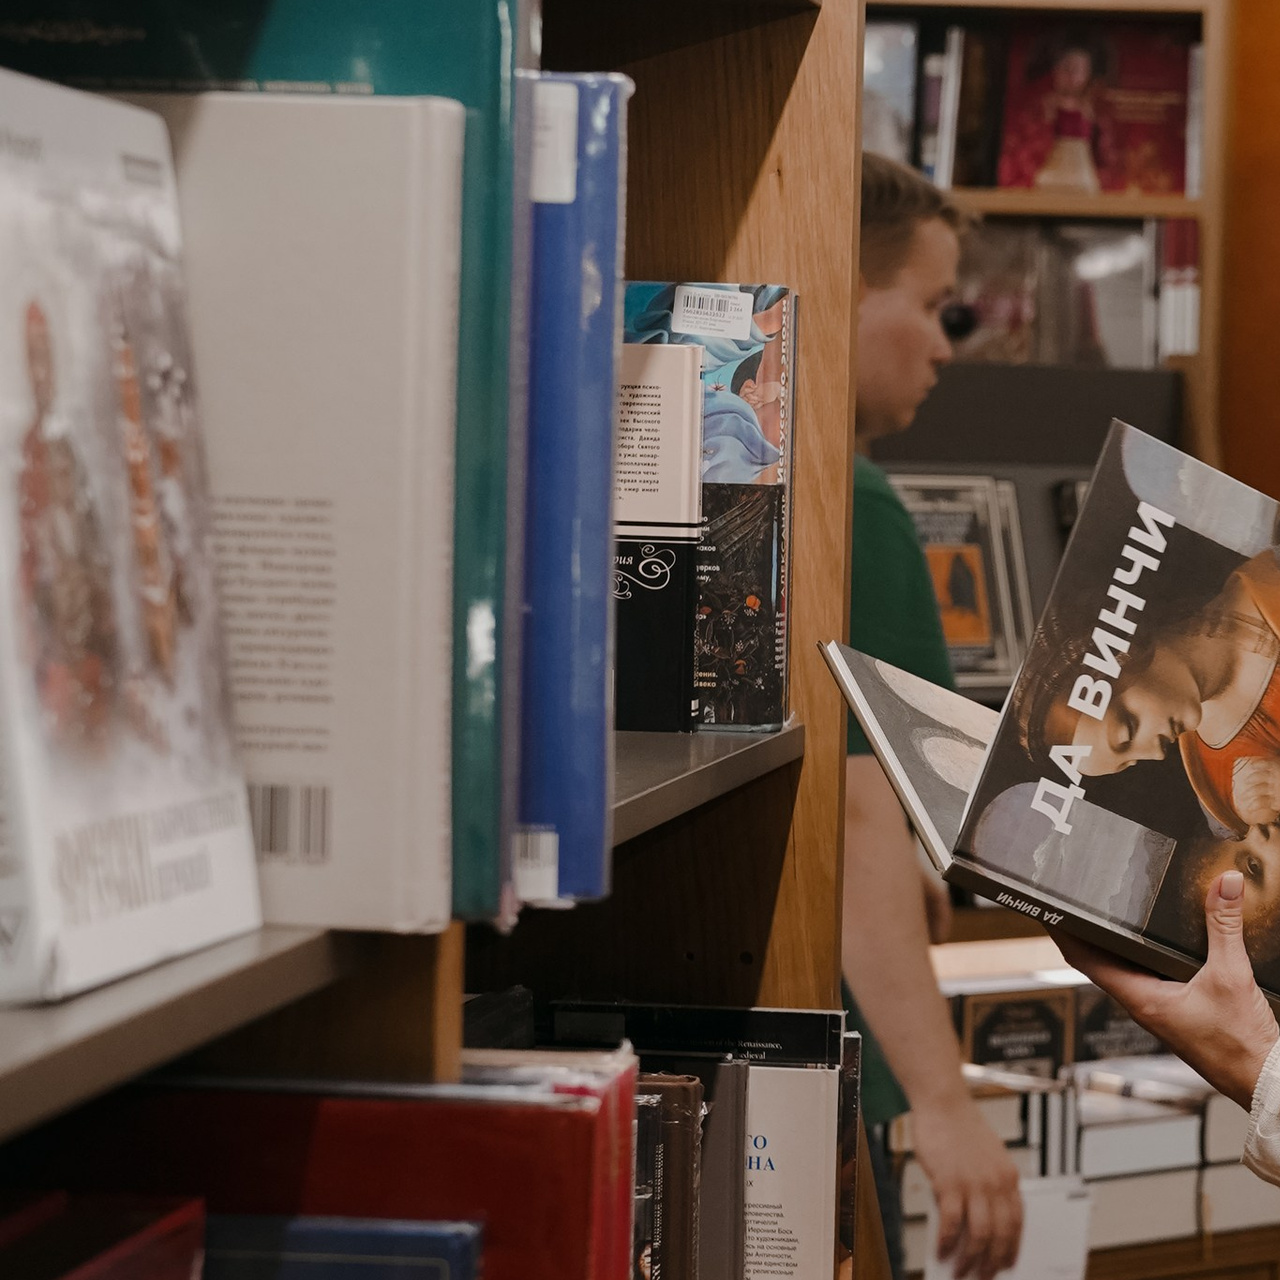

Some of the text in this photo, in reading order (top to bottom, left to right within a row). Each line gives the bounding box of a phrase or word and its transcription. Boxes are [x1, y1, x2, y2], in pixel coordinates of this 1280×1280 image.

[776, 299, 788, 483] Искусство эпохи
[639, 434, 660, 442] Давида
[1030, 500, 1176, 836] ДА ВИНЧИ
[995, 891, 1064, 926] ДА ВИНЧИ
[737, 1040, 783, 1050] Renaissance,
[739, 1051, 766, 1060] edieval
[745, 1156, 776, 1172] НА
[744, 1202, 783, 1210] рессивный
[747, 1226, 793, 1235] Иероним Босх
[756, 1236, 800, 1244] художниками,
[765, 1244, 797, 1252] основные
[755, 1251, 793, 1260] Античности,
[763, 1260, 798, 1268] единством
[752, 1268, 794, 1276] религиозные
